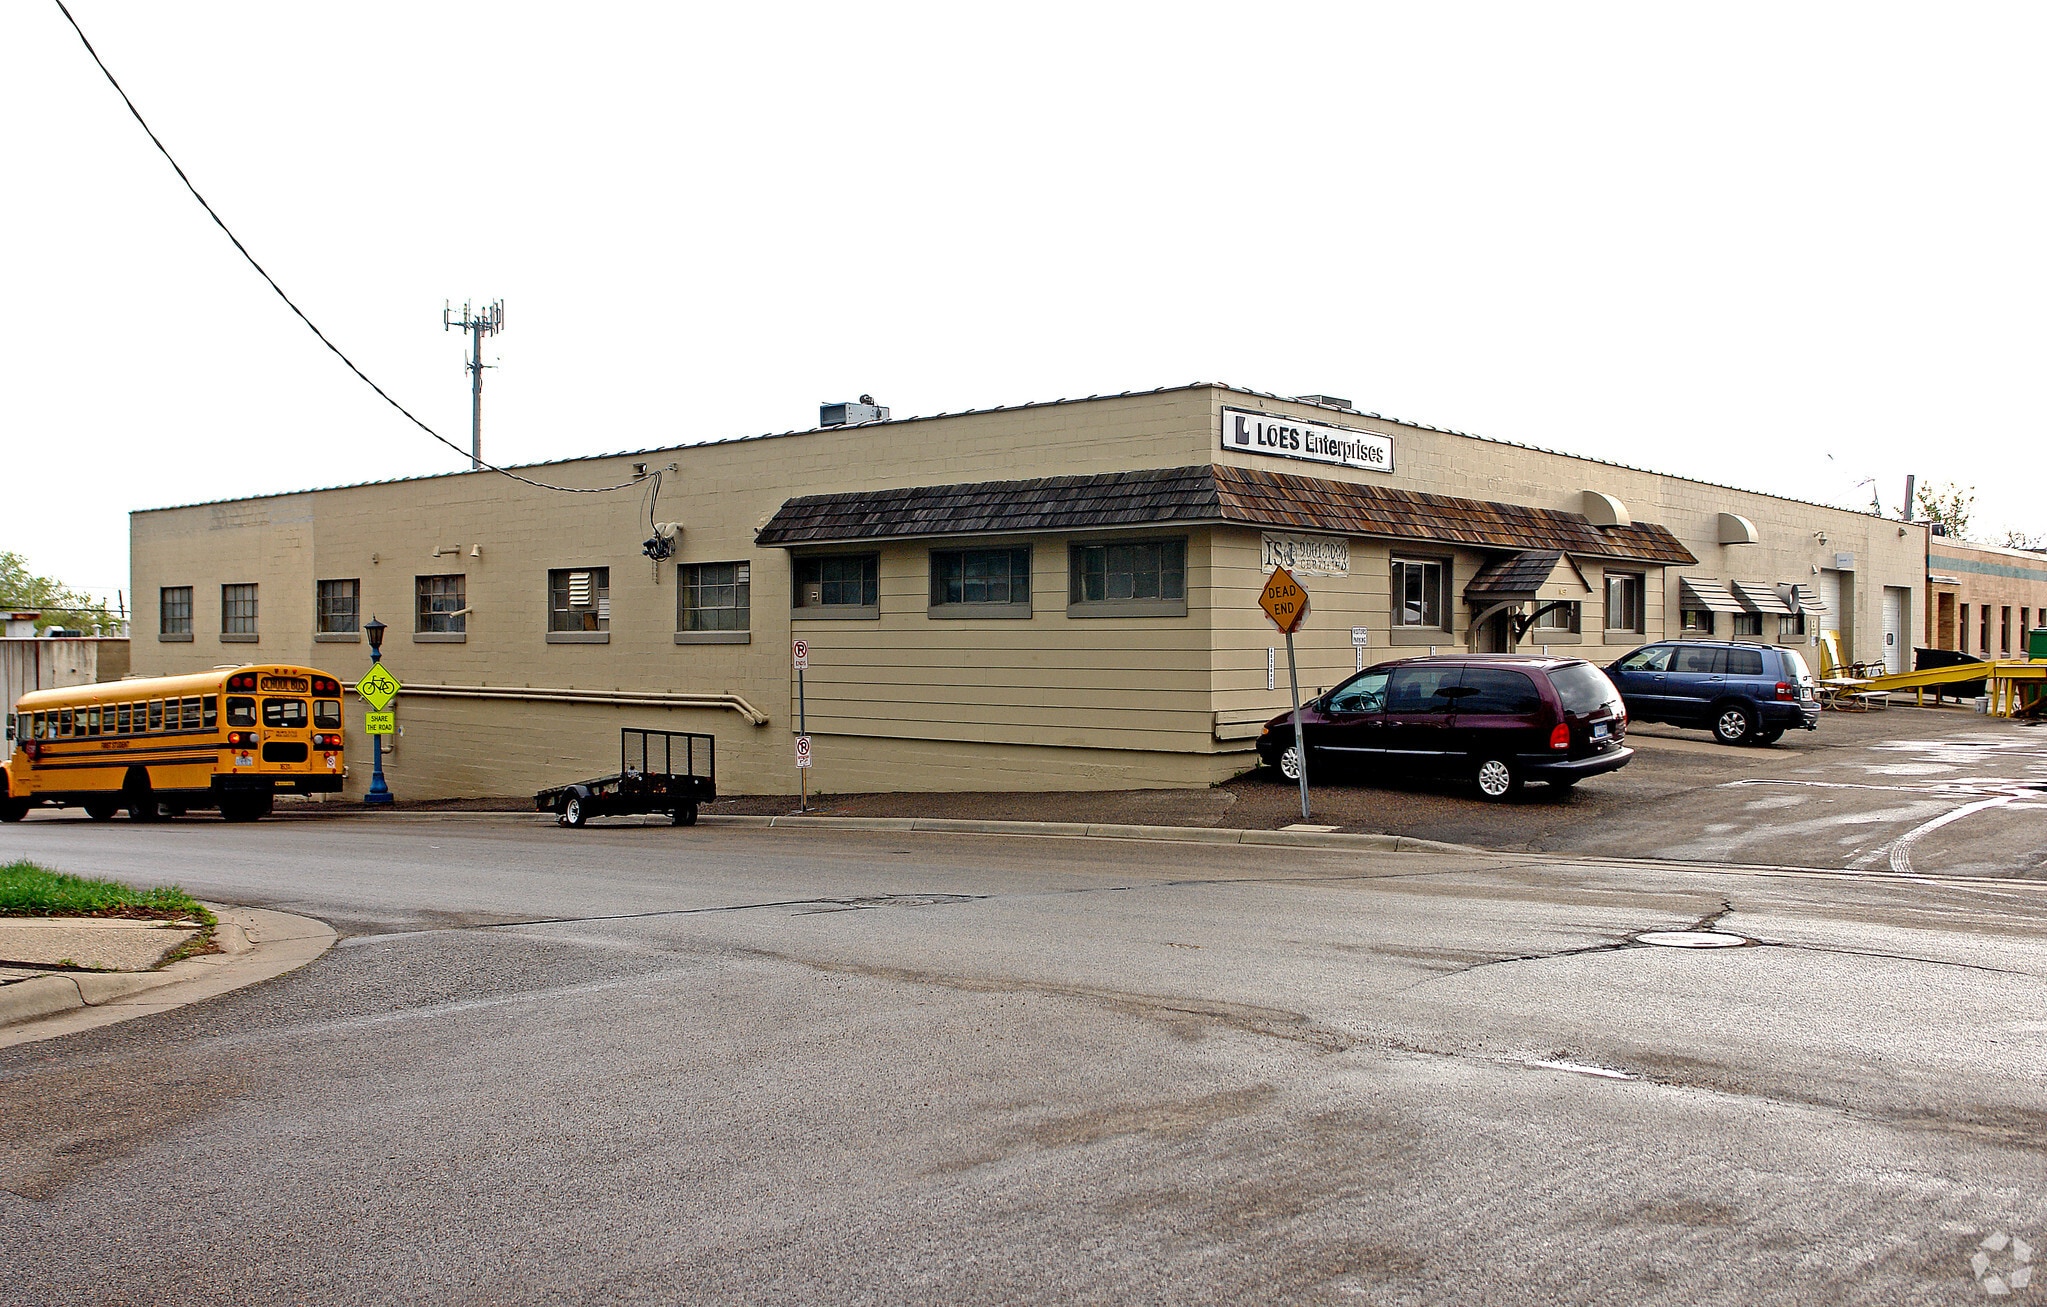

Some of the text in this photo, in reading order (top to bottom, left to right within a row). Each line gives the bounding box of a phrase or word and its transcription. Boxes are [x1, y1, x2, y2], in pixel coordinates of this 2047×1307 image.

[1257, 422, 1300, 451] LOES
[1305, 430, 1384, 463] Enterprises
[1268, 584, 1296, 599] DEAD
[1274, 602, 1295, 615] END
[261, 678, 307, 692] SCHOOL BUS
